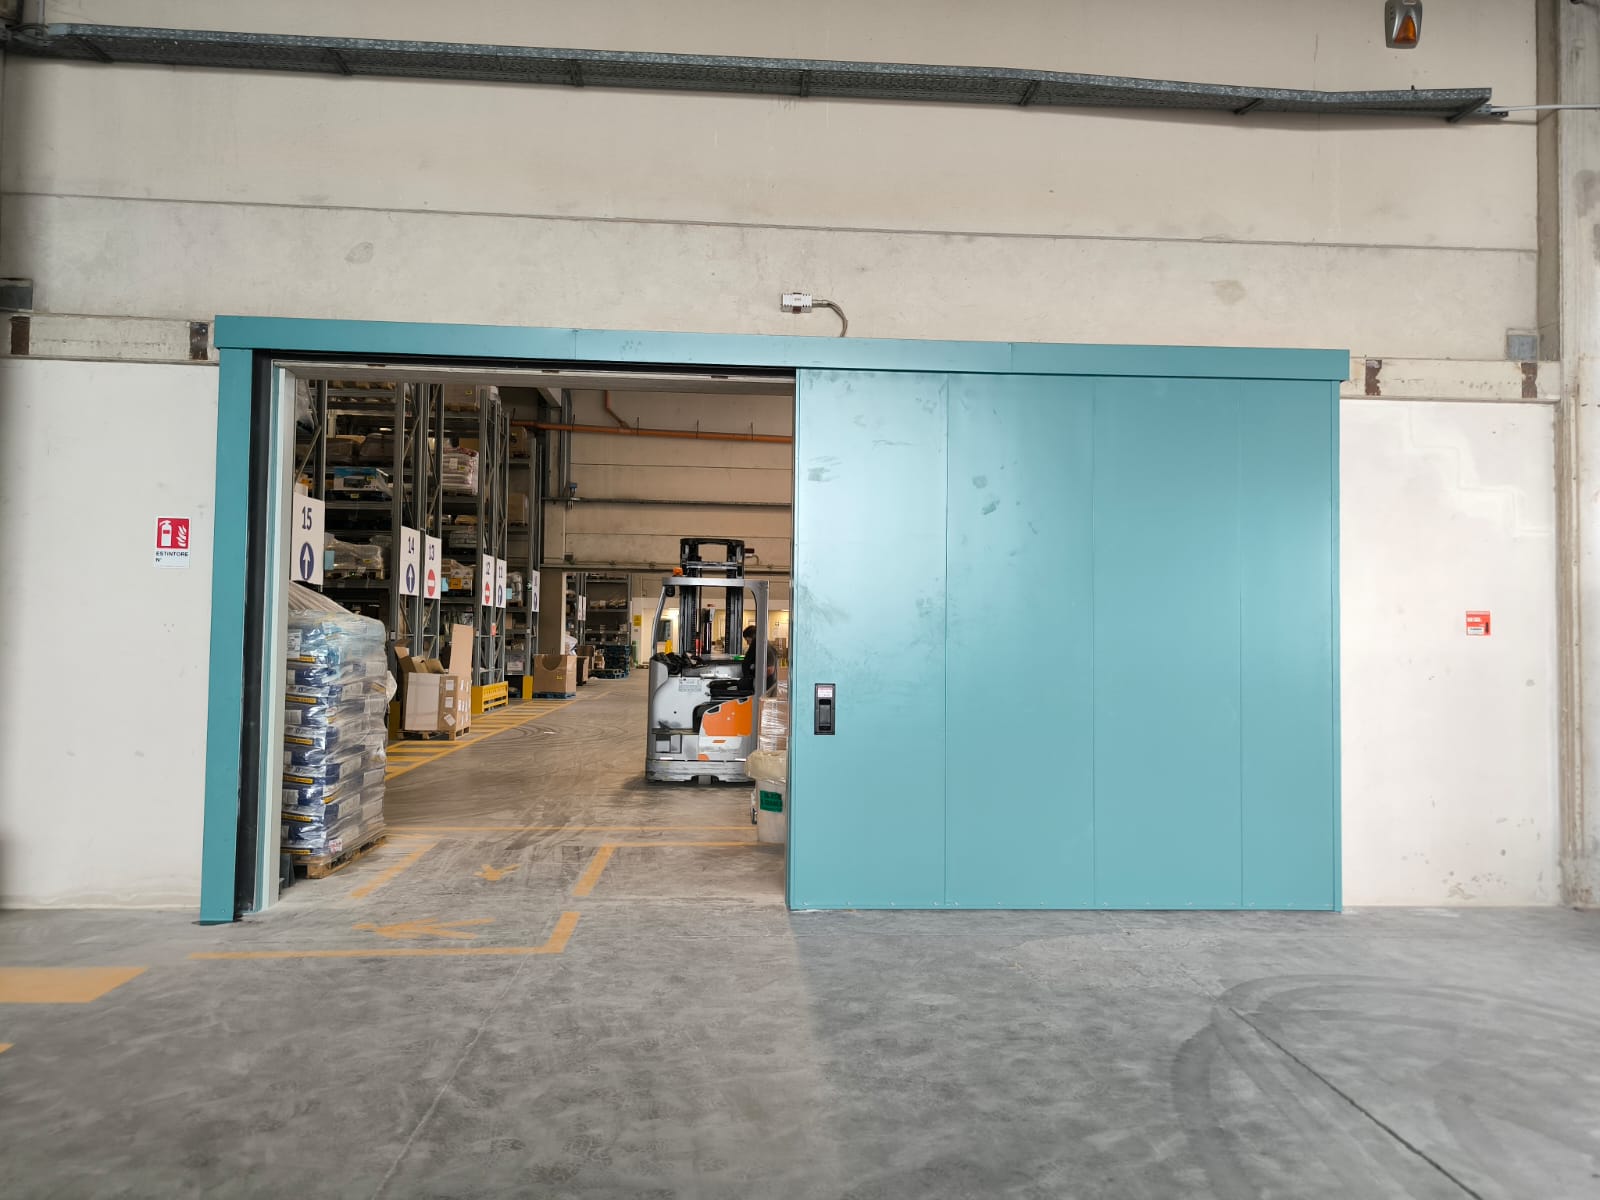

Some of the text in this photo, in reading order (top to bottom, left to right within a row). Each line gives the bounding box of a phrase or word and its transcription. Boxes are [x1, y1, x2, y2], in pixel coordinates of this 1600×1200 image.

[302, 506, 312, 530] 15
[408, 535, 415, 555] 14
[428, 544, 435, 561] 13
